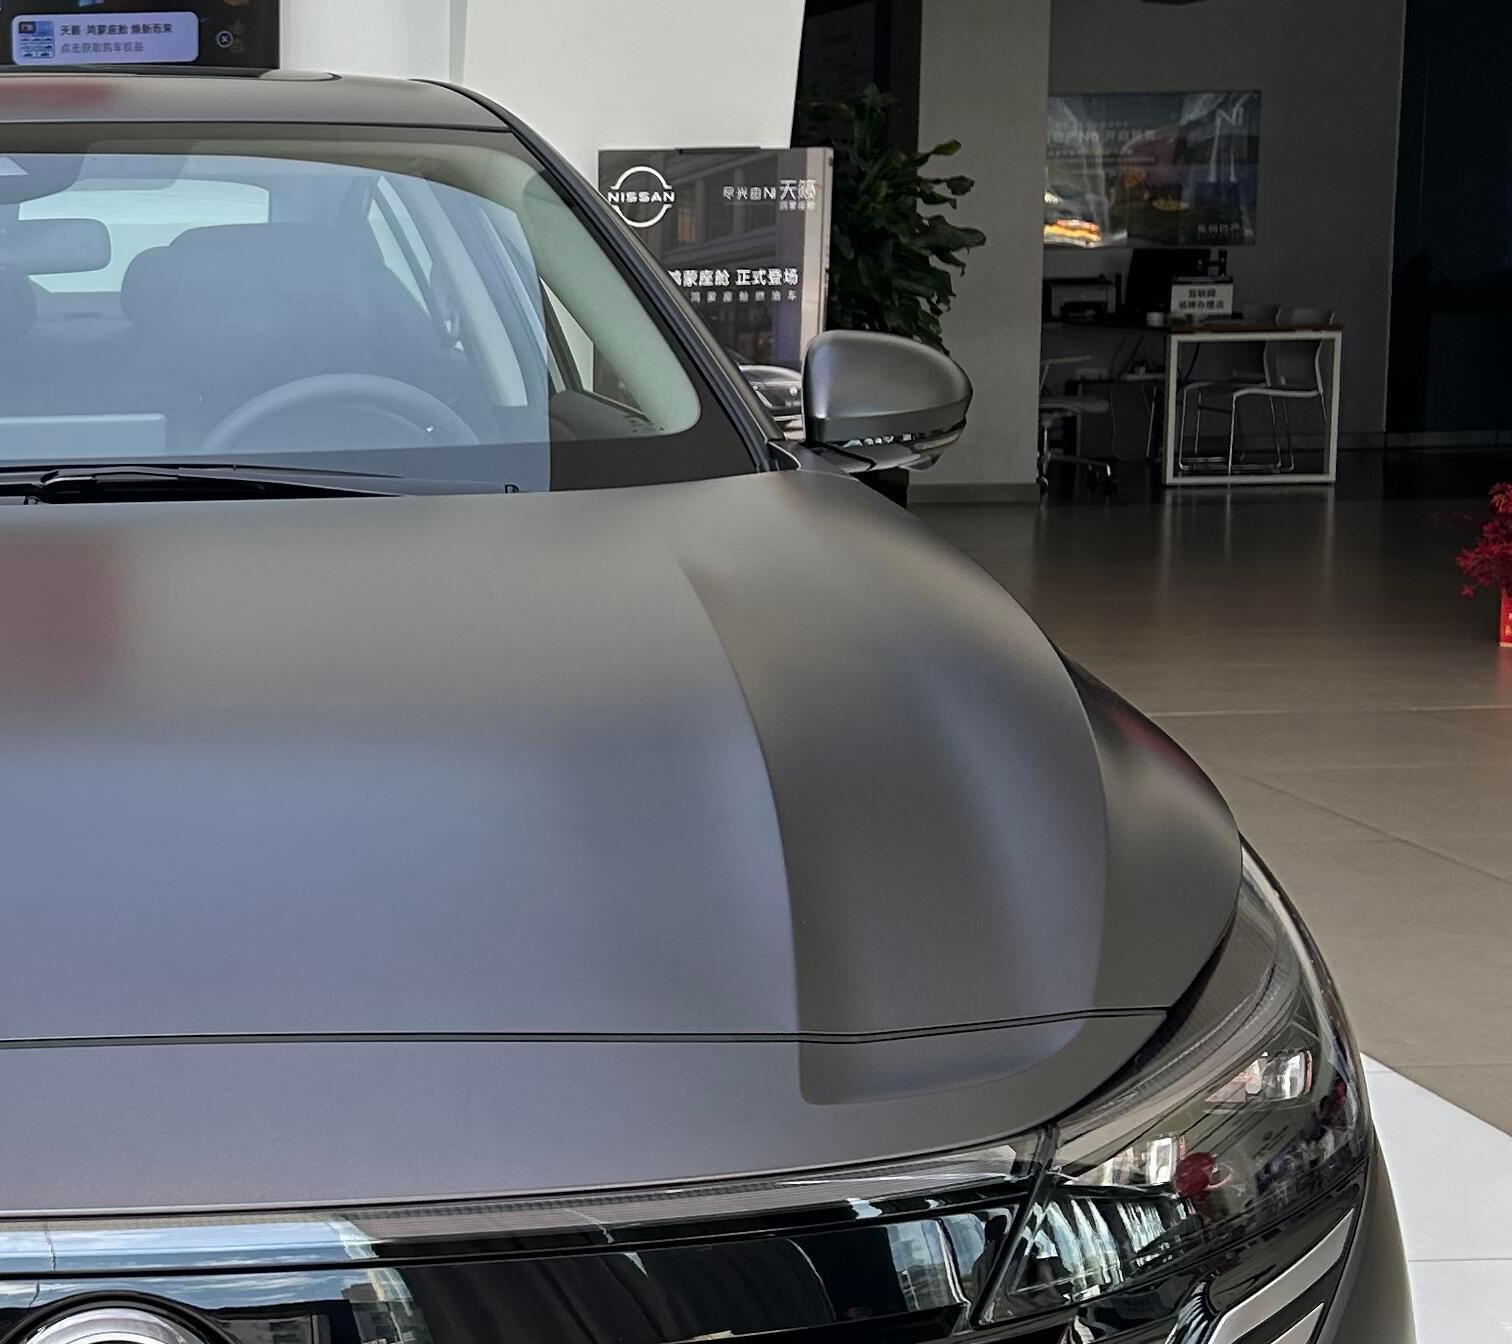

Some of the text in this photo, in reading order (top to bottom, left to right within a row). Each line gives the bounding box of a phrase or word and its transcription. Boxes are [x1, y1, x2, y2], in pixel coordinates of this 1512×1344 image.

[607, 191, 675, 203] NISSAN
[780, 179, 817, 200] 天籁
[736, 268, 798, 286] 正式登场
